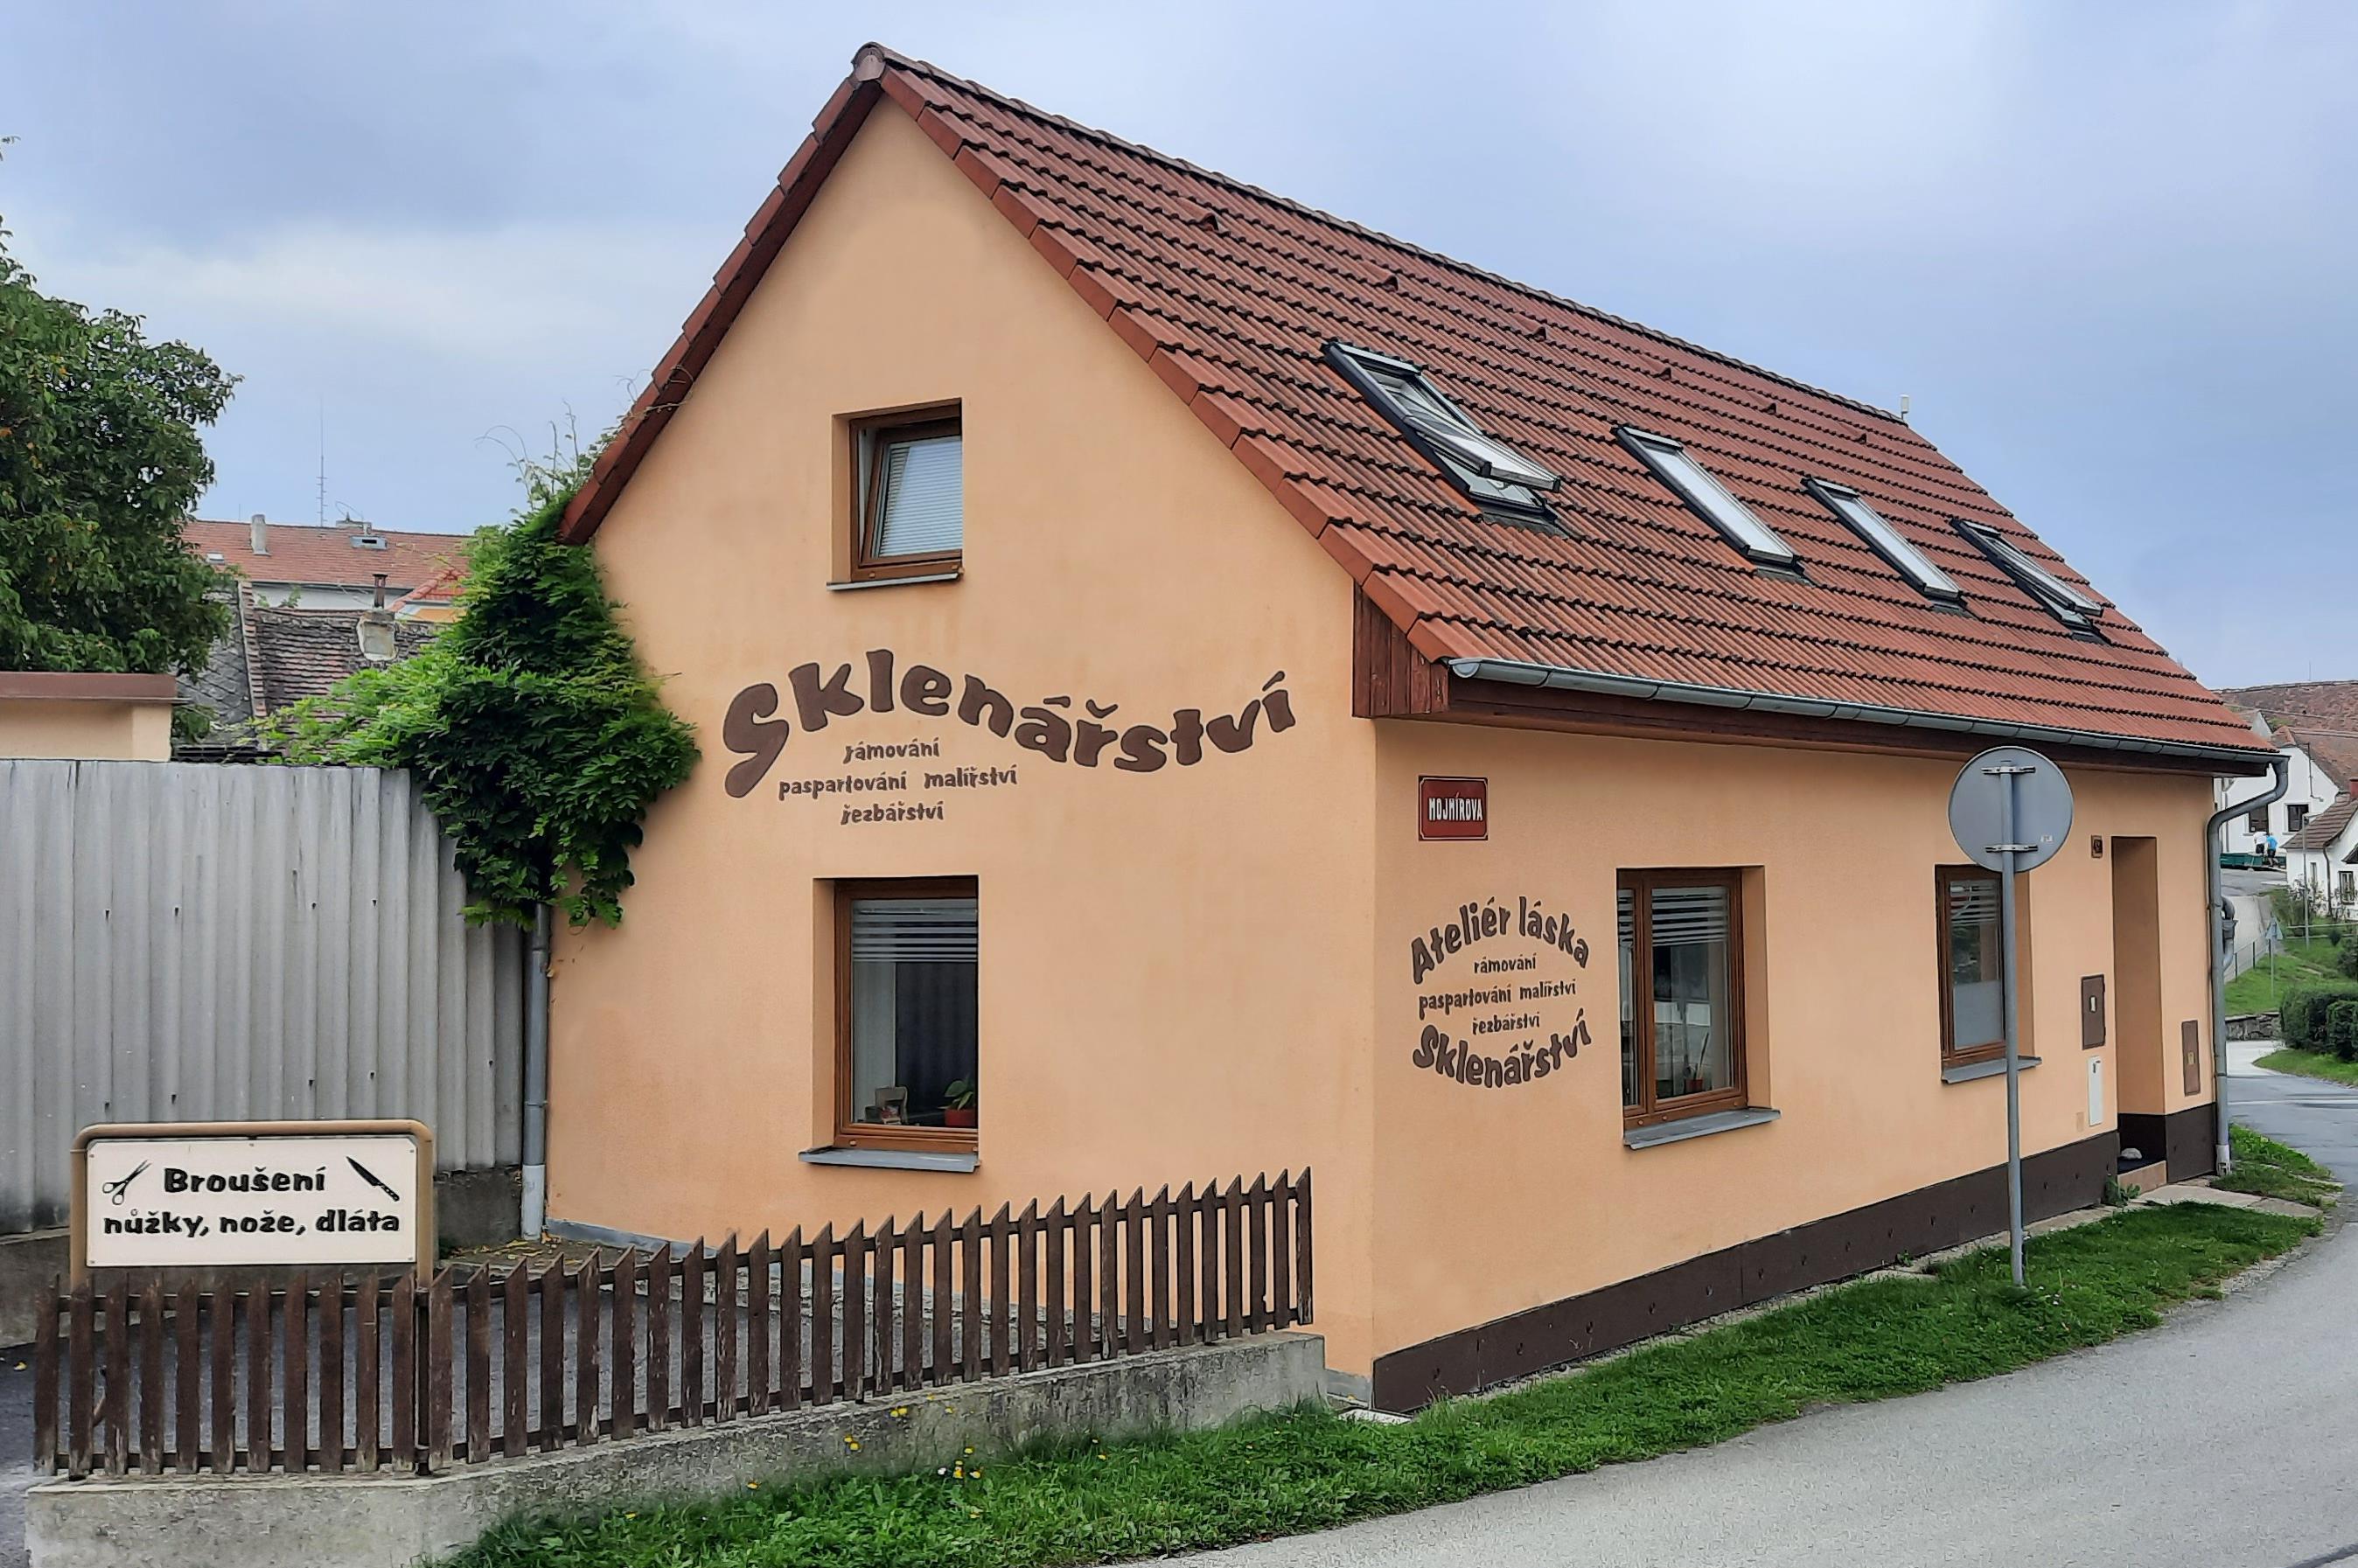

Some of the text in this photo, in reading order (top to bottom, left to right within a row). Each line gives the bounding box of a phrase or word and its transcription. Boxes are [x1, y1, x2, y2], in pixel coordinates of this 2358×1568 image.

[722, 649, 1296, 798] Sklenářství
[842, 737, 940, 764] rámování
[778, 764, 1018, 801] paspartování malířství
[841, 801, 945, 826] řezbářství
[1428, 791, 1483, 821] MOJMÍROVA
[1412, 896, 1589, 985] Ateliér láska
[1474, 952, 1537, 973] rámování
[1419, 979, 1576, 1021] paspartování malířství
[1472, 1011, 1540, 1035] řezbářství
[1413, 1007, 1592, 1088] Sklenářství
[163, 1167, 327, 1194] Broušení
[103, 1209, 401, 1237] nůžky, nože, dláta
